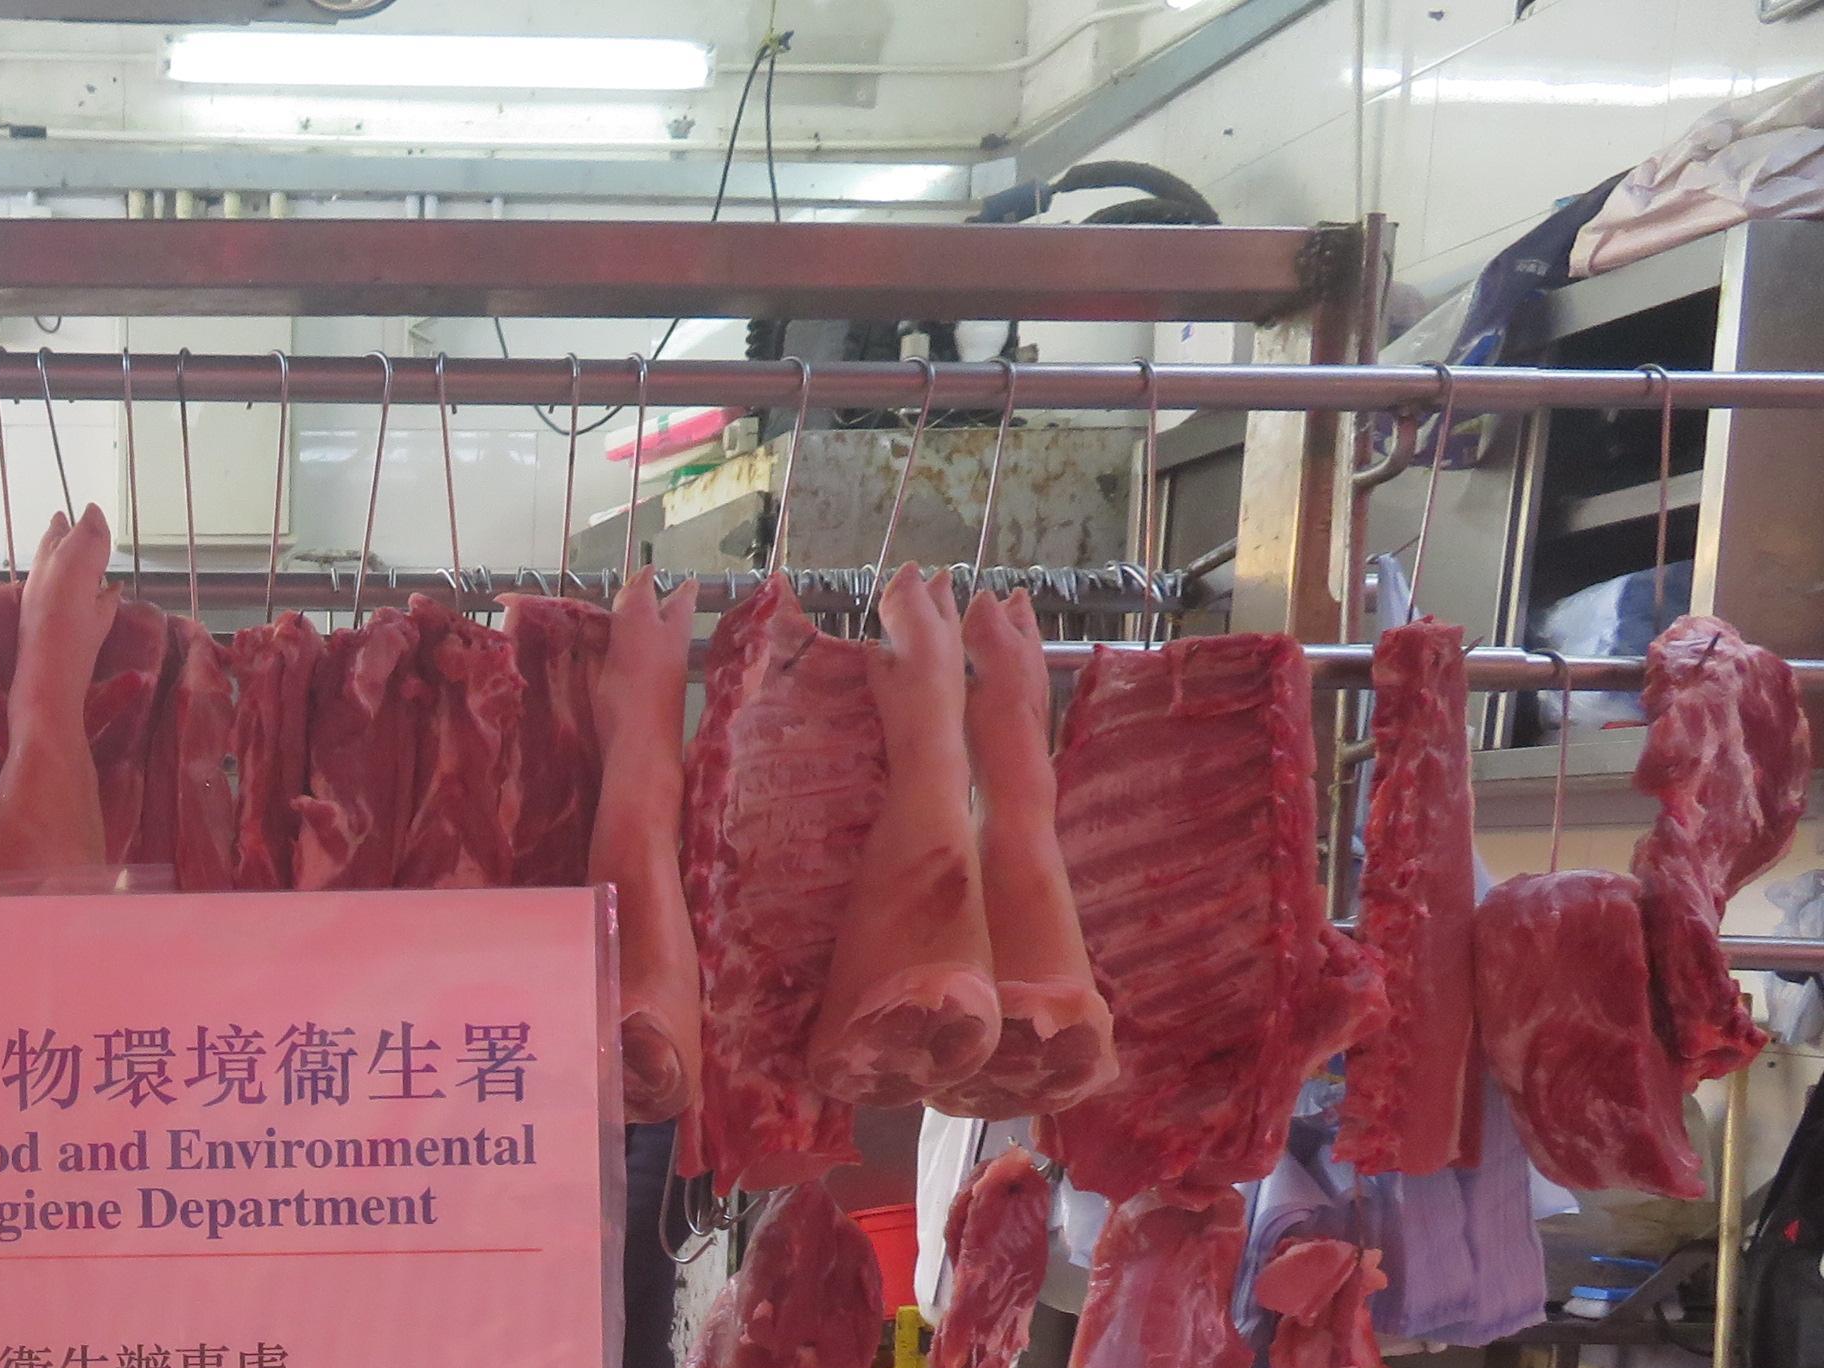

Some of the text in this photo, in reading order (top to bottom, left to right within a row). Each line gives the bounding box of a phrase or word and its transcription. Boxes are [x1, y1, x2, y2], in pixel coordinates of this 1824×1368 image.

[59, 1130, 150, 1172] and
[167, 1125, 536, 1170] Environmental
[137, 1187, 437, 1239] Department
